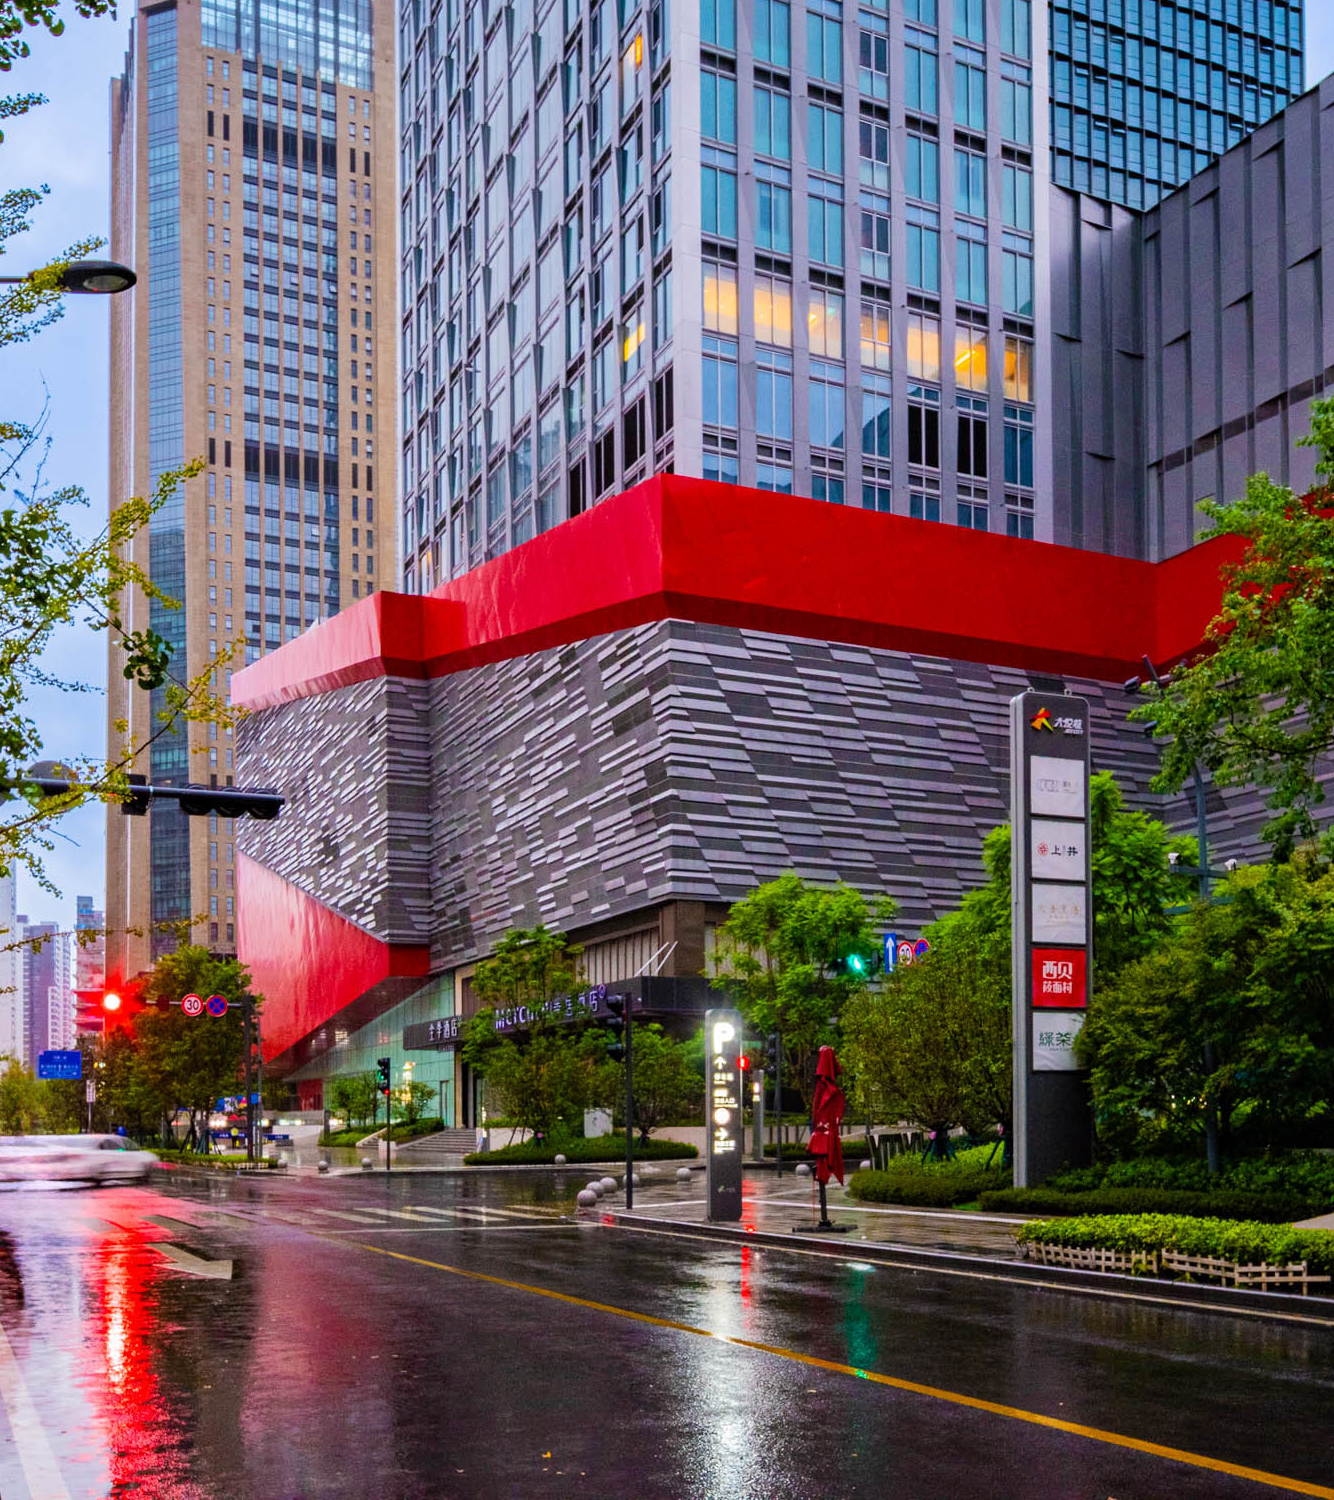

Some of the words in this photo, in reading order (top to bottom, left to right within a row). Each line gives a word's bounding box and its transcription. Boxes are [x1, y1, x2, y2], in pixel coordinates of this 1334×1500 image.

[1042, 960, 1073, 980] 西贝
[1042, 980, 1073, 994] 莜面村
[186, 999, 200, 1011] 30
[428, 1017, 458, 1043] 全季酒店
[713, 1022, 735, 1054] P
